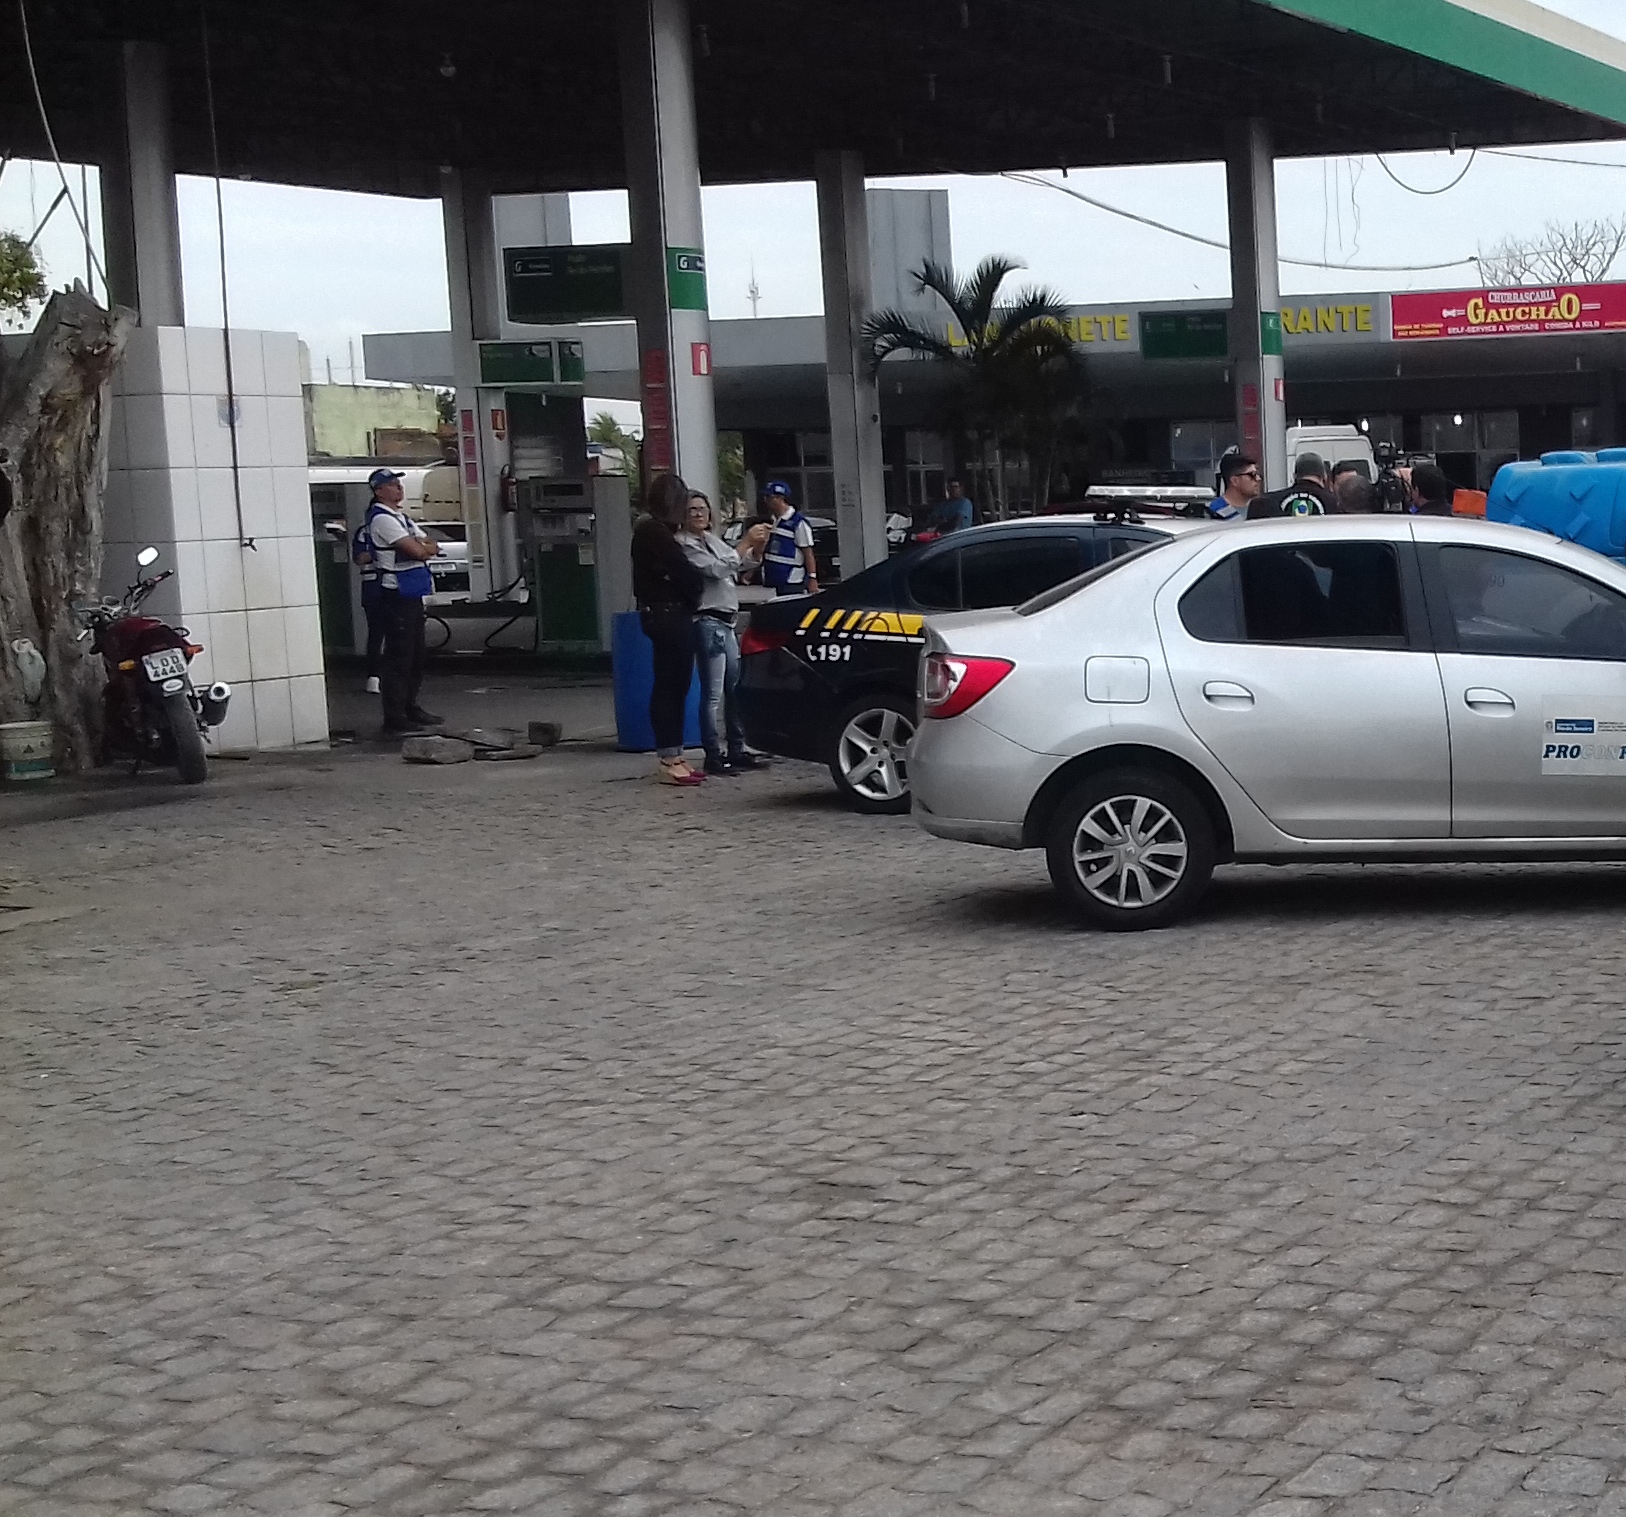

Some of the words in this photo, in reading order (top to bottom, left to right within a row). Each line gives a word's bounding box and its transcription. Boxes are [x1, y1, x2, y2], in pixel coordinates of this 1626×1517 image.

[679, 255, 688, 269] G
[1488, 289, 1557, 304] CHURRASCARIA
[1467, 292, 1580, 325] GAUCHÃO
[816, 644, 852, 661] 191
